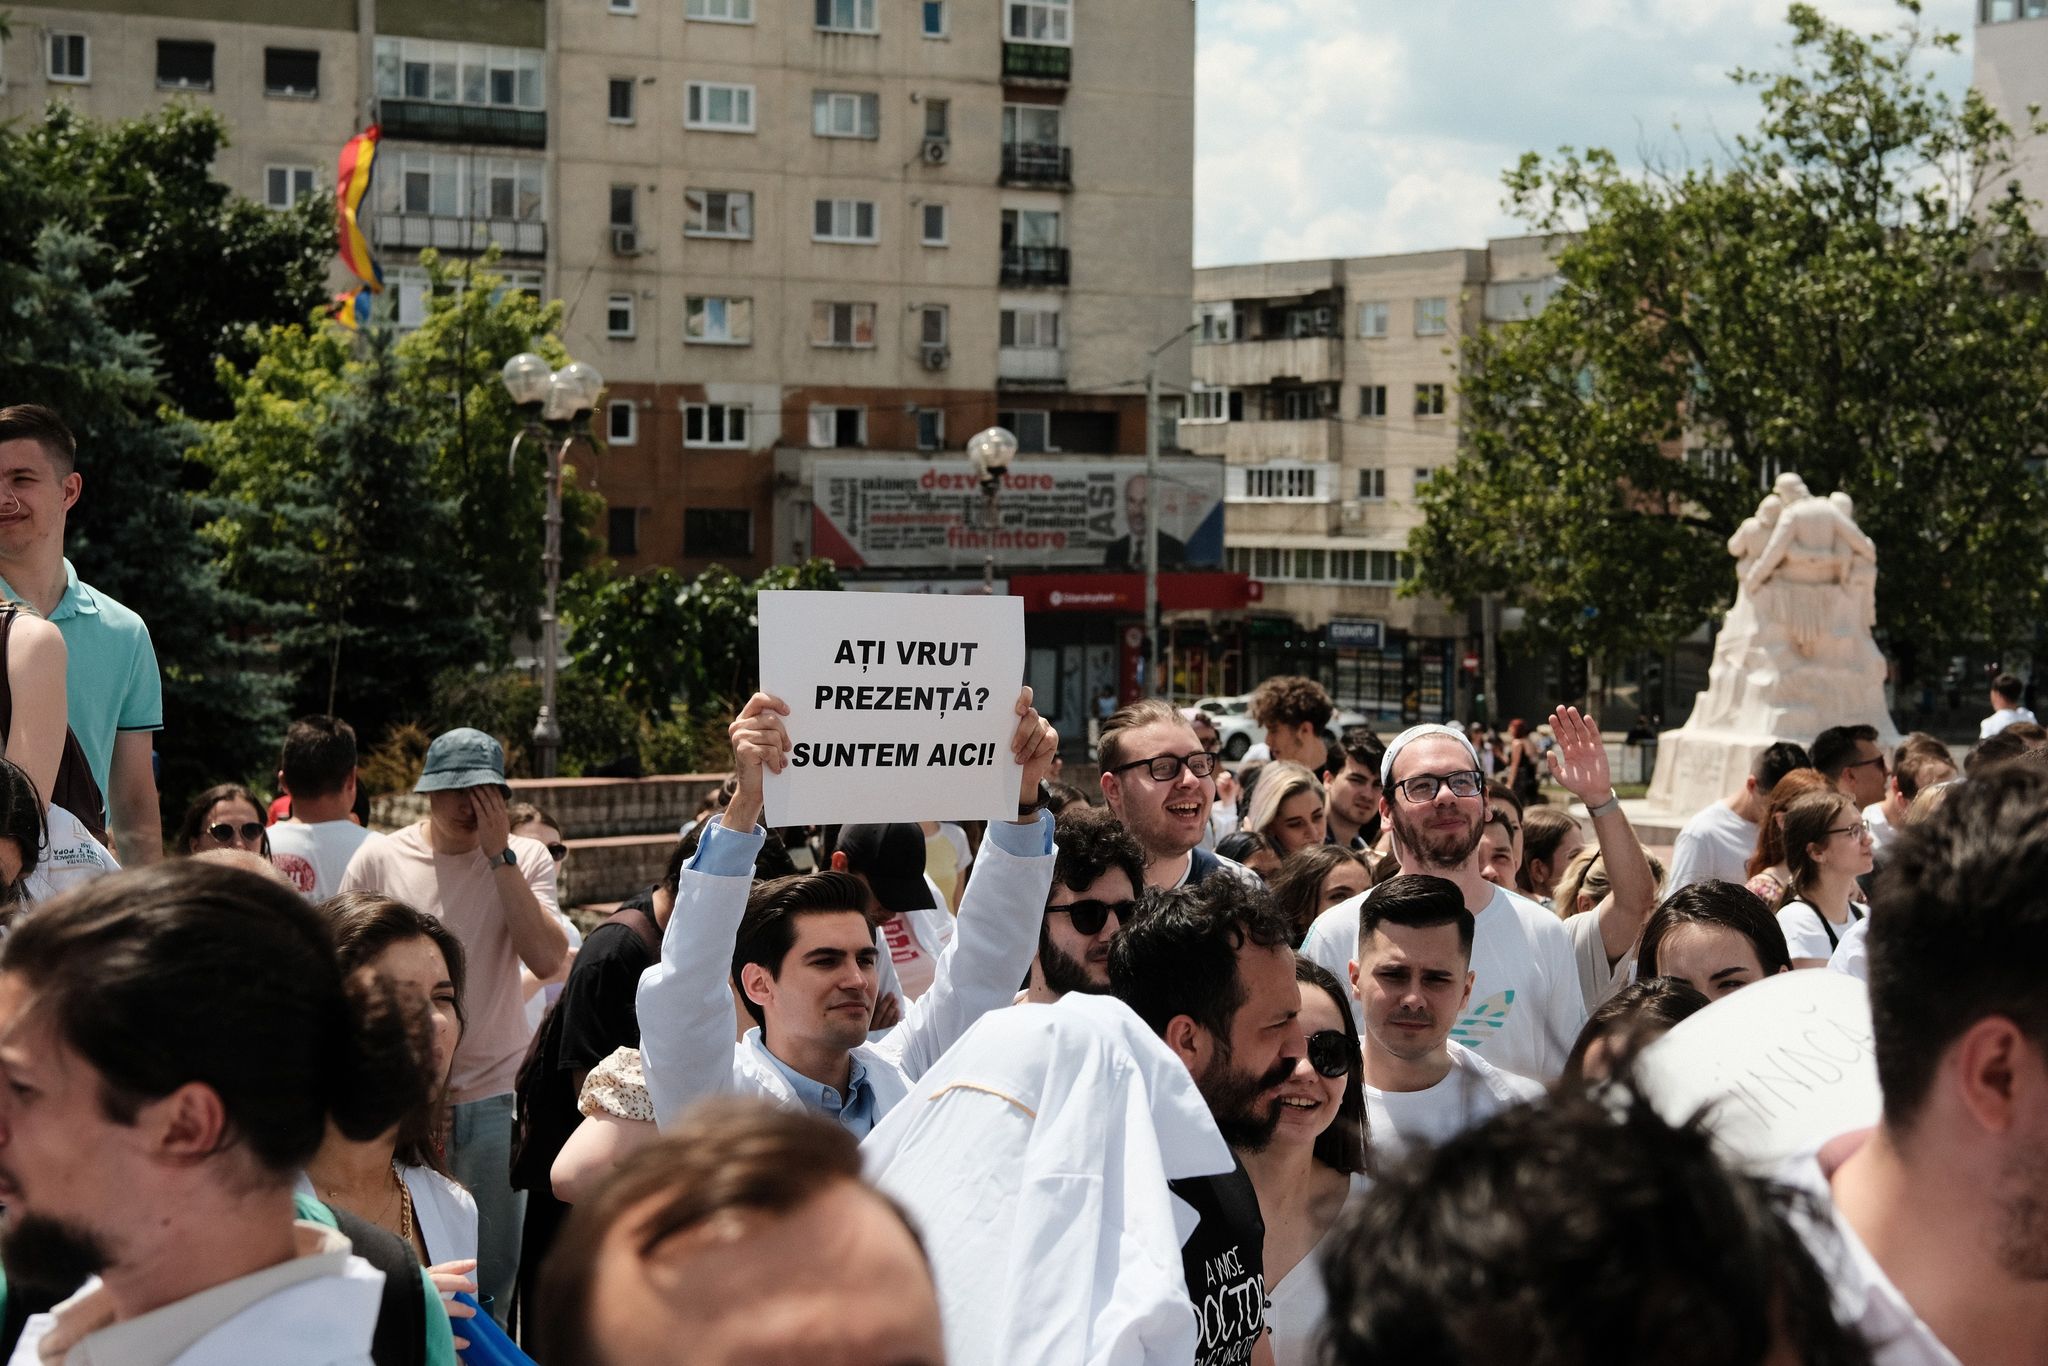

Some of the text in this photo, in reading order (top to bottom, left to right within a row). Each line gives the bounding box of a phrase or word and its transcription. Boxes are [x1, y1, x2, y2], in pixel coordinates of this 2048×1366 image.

[921, 468, 1053, 491] dezvtare
[834, 639, 978, 673] AȚI VRUT
[814, 681, 990, 719] PREZENȚĂ?
[791, 742, 996, 768] SUNTEM AICI!
[1205, 1245, 1245, 1288] A WISE
